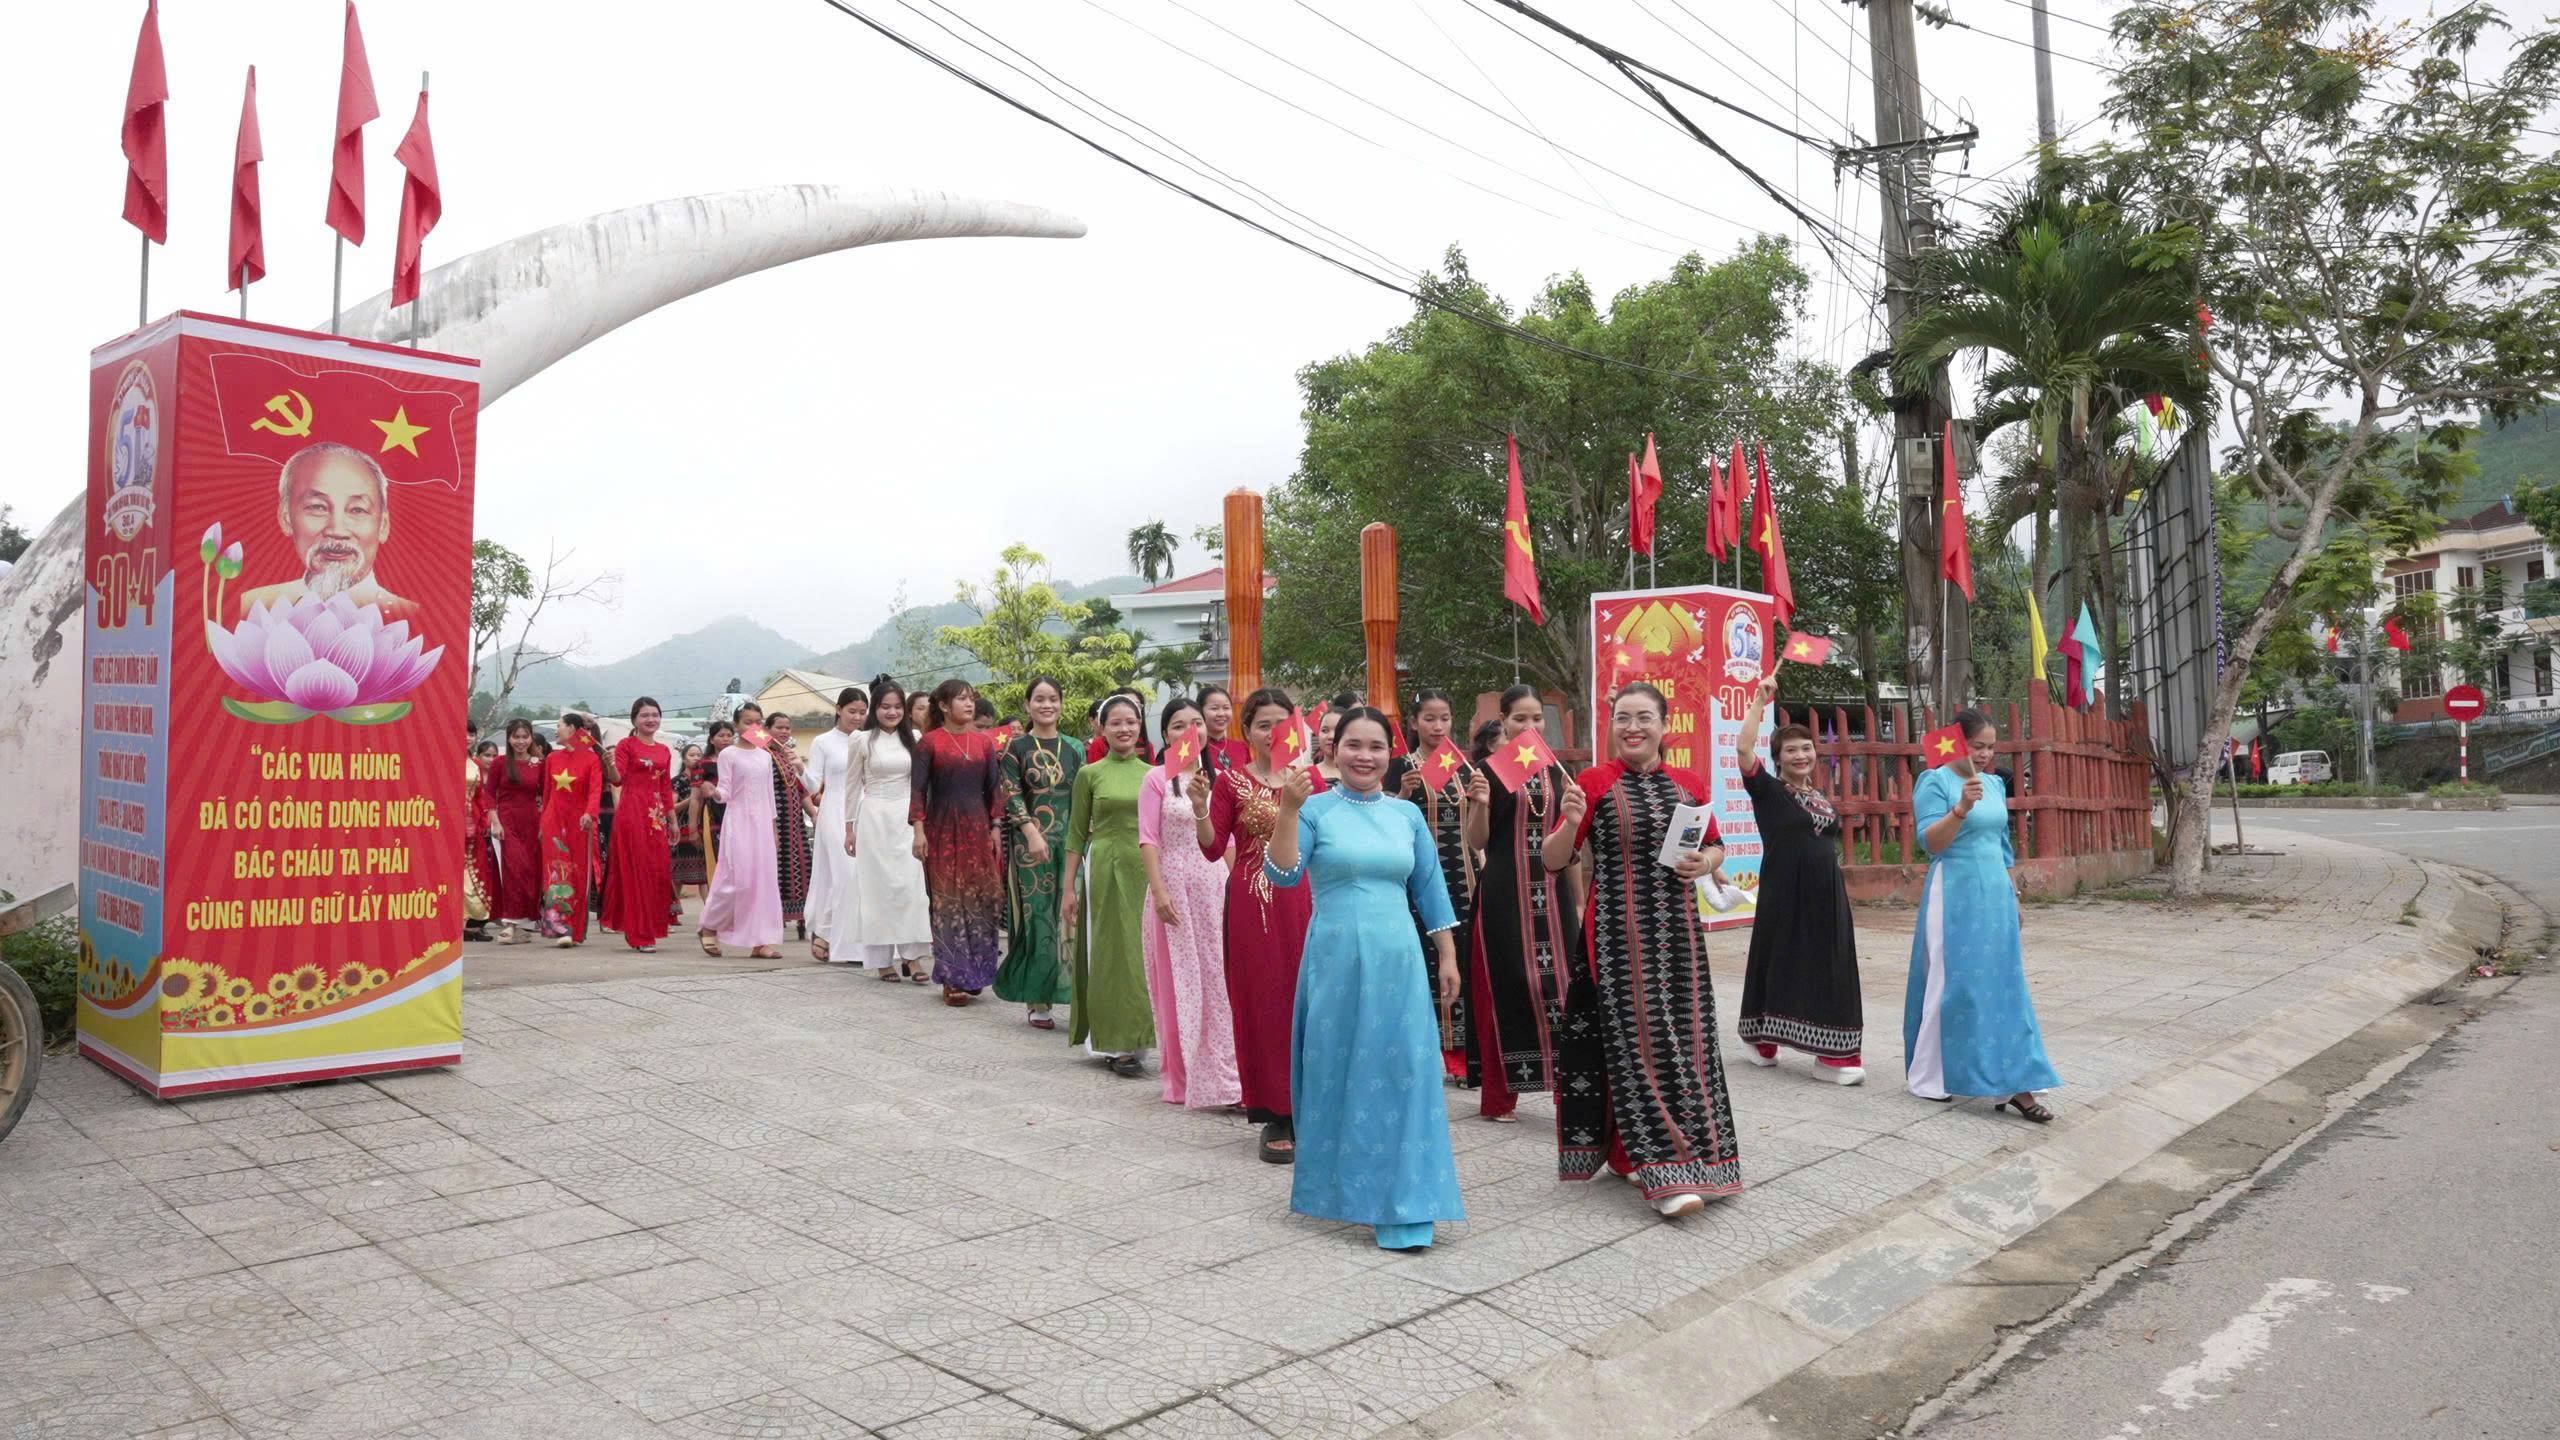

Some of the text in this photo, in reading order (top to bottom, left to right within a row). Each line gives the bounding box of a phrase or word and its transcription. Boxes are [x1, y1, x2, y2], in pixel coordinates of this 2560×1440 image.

[97, 552, 129, 629] 30
[1720, 685, 1746, 721] 30
[251, 744, 400, 780] “CÁC VUA HÙNG
[200, 795, 440, 834] ĐÃ CÓ CÔNG DỰNG NƯỚC,
[234, 838, 409, 879] BÁC CHÁU TA PHẢI
[186, 884, 447, 931] CÙNG NHAU GIỮ LẤY NƯỚC”
